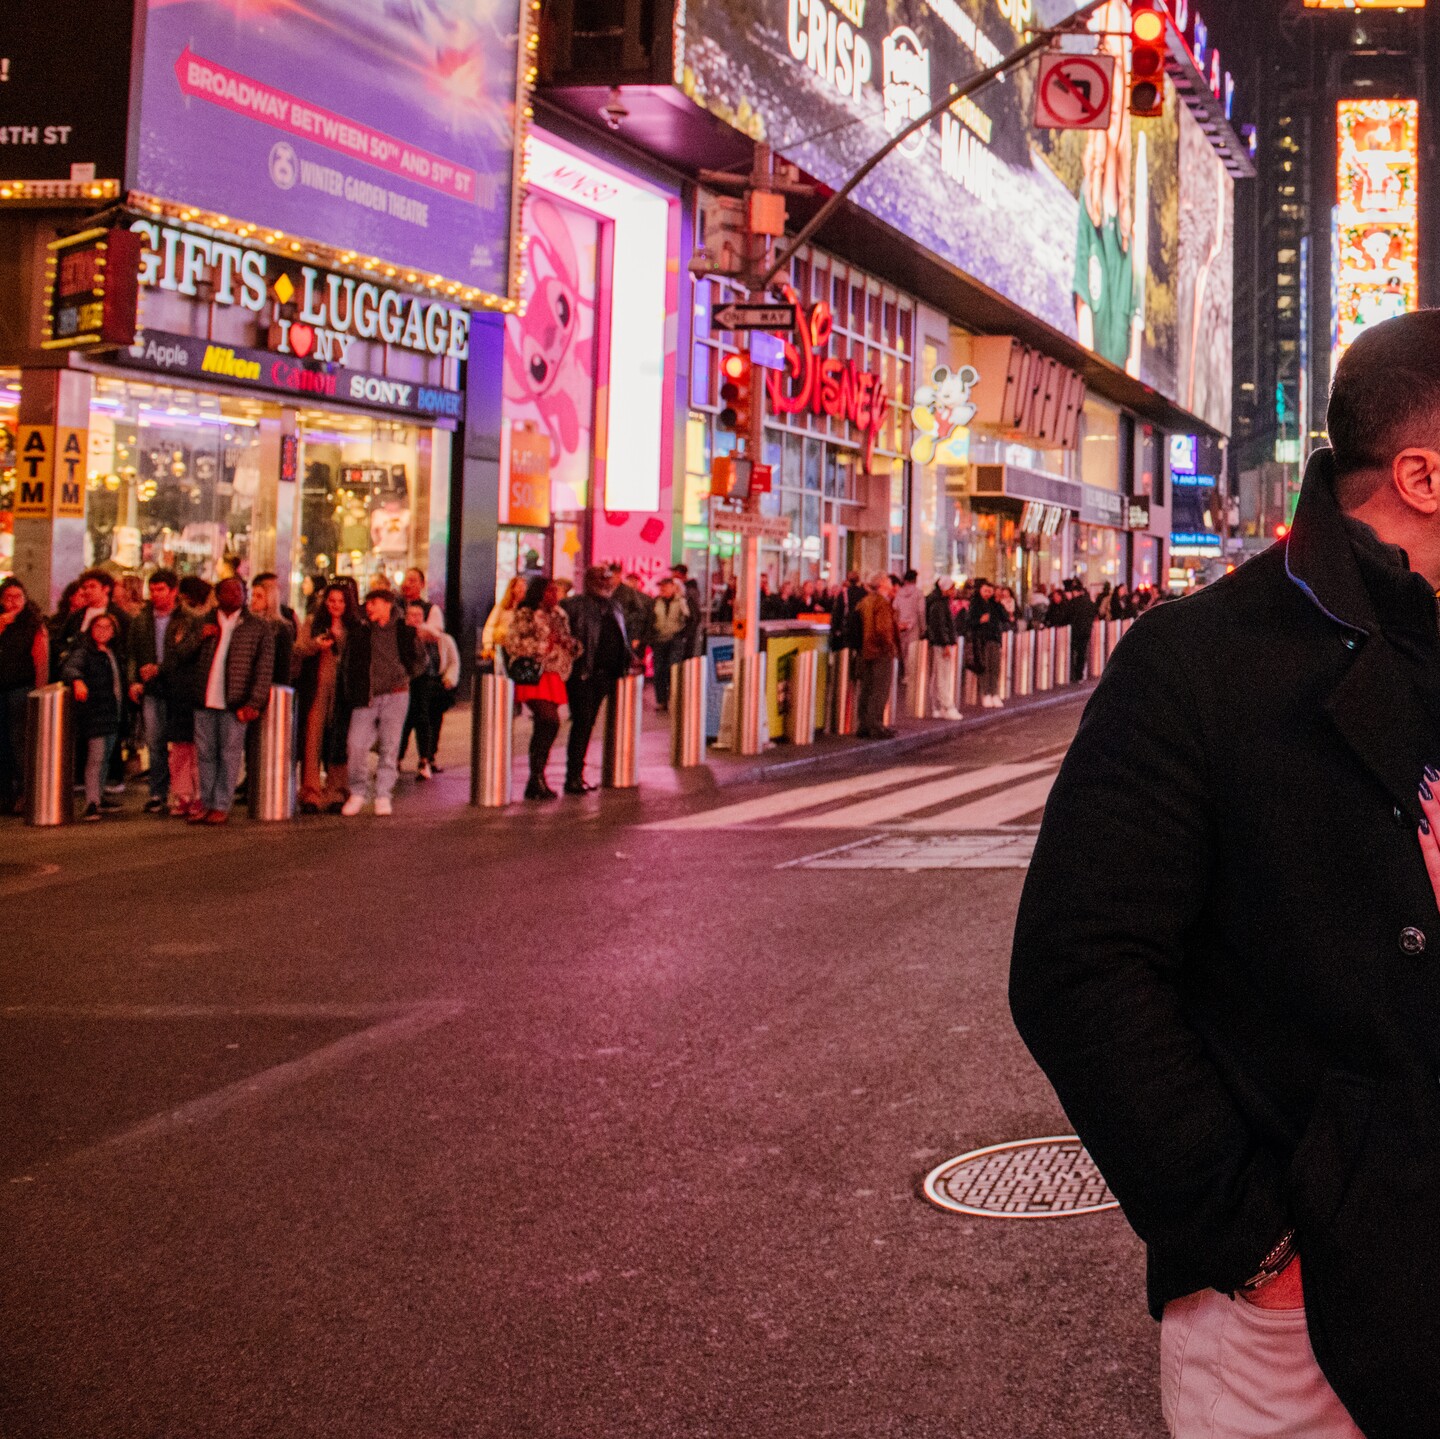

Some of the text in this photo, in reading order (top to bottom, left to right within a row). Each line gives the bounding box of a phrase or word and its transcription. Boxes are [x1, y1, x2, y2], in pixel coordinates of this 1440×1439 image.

[787, 0, 871, 106] CRISP
[43, 125, 73, 145] ST
[186, 61, 289, 121] BROADWAY
[290, 105, 369, 155] BETWEEN
[369, 136, 399, 161] 50TH
[399, 147, 432, 176] AND
[454, 168, 472, 193] ST
[300, 158, 429, 228] WINTER GARDEN THEATRE
[129, 219, 268, 312] GIFTS
[299, 265, 471, 361] LUGGAGE
[759, 312, 786, 323] WAY
[145, 340, 189, 367] Apple
[201, 345, 262, 381] Nikon
[277, 317, 357, 366] I NY
[271, 359, 338, 396] Canon
[350, 373, 412, 407] SONY
[417, 387, 461, 416] BOWER
[21, 431, 46, 503] ATM
[62, 433, 81, 505] ATM
